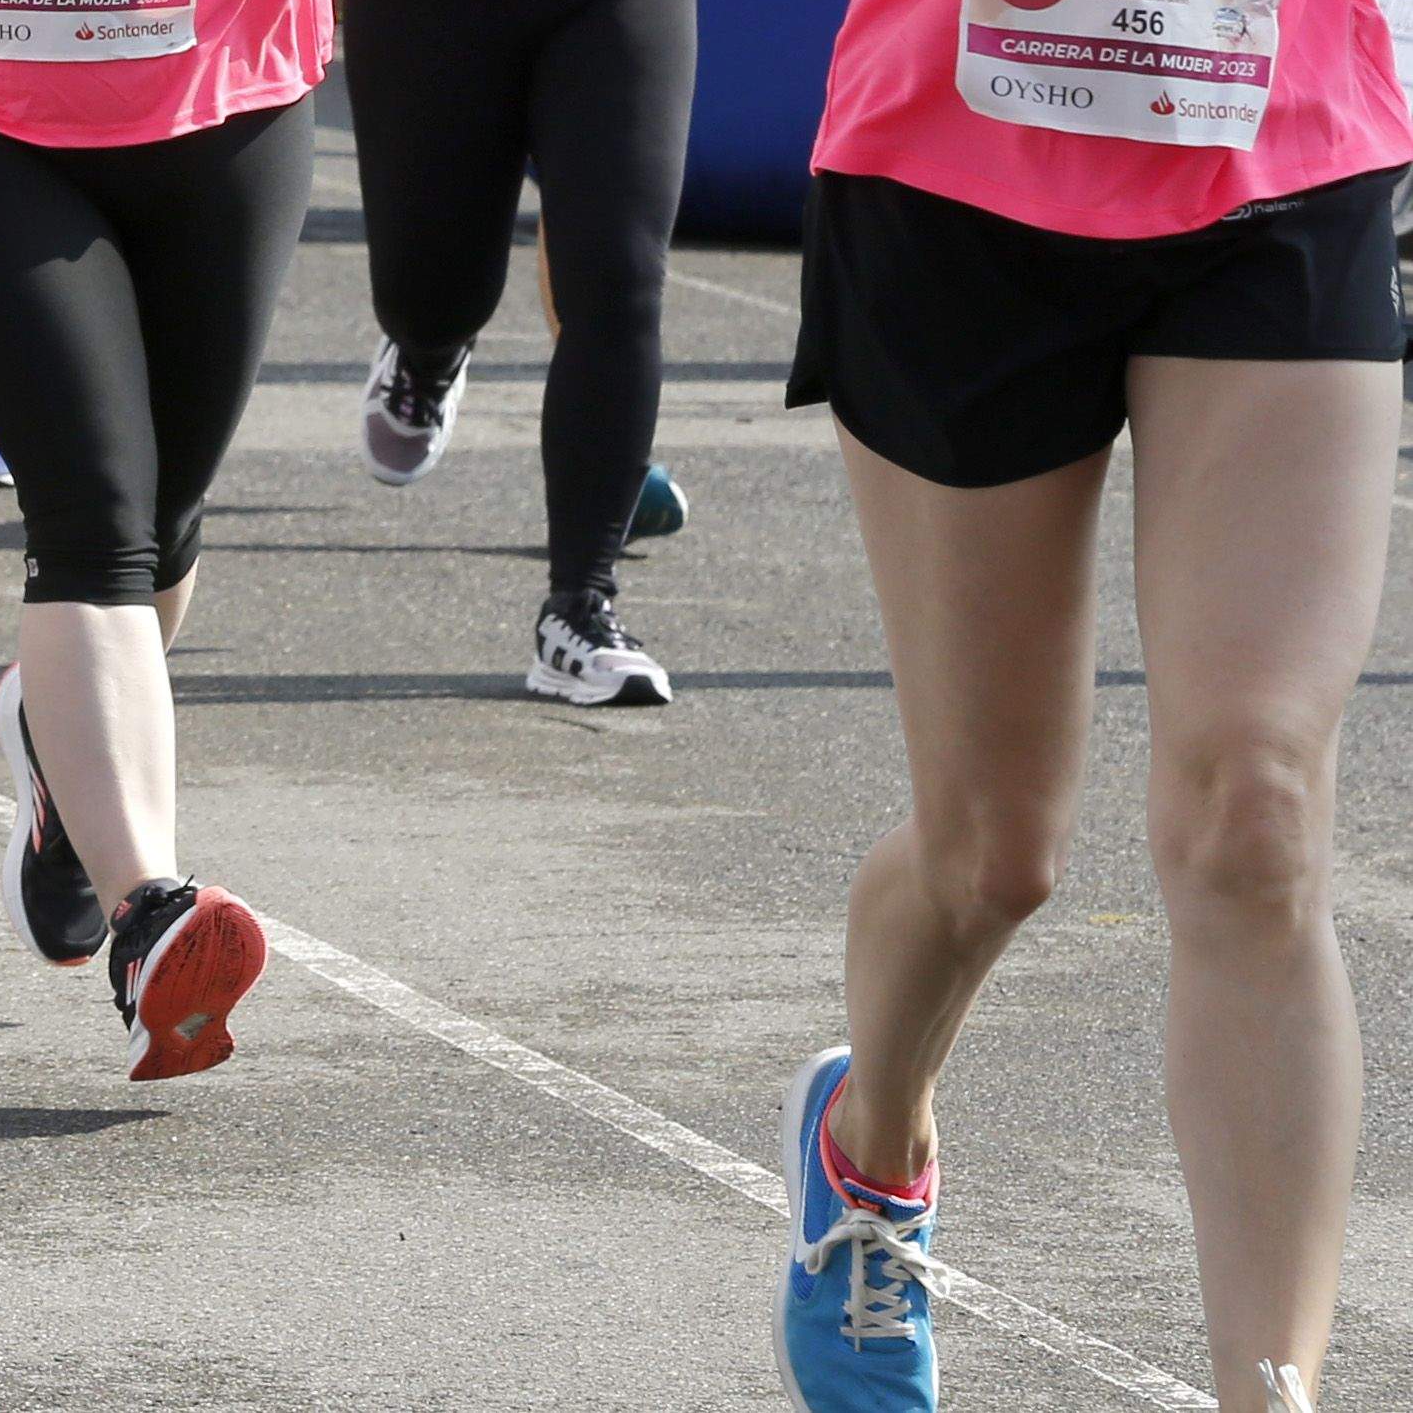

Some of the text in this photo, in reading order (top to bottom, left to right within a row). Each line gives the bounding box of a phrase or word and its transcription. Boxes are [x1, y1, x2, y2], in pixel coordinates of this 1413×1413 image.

[97, 22, 174, 40] Santander
[1112, 8, 1164, 35] 456
[1000, 38, 1256, 78] CARRERA DE LA MUJER 2023
[990, 75, 1094, 109] OYSHO
[1178, 96, 1257, 123] Santander
